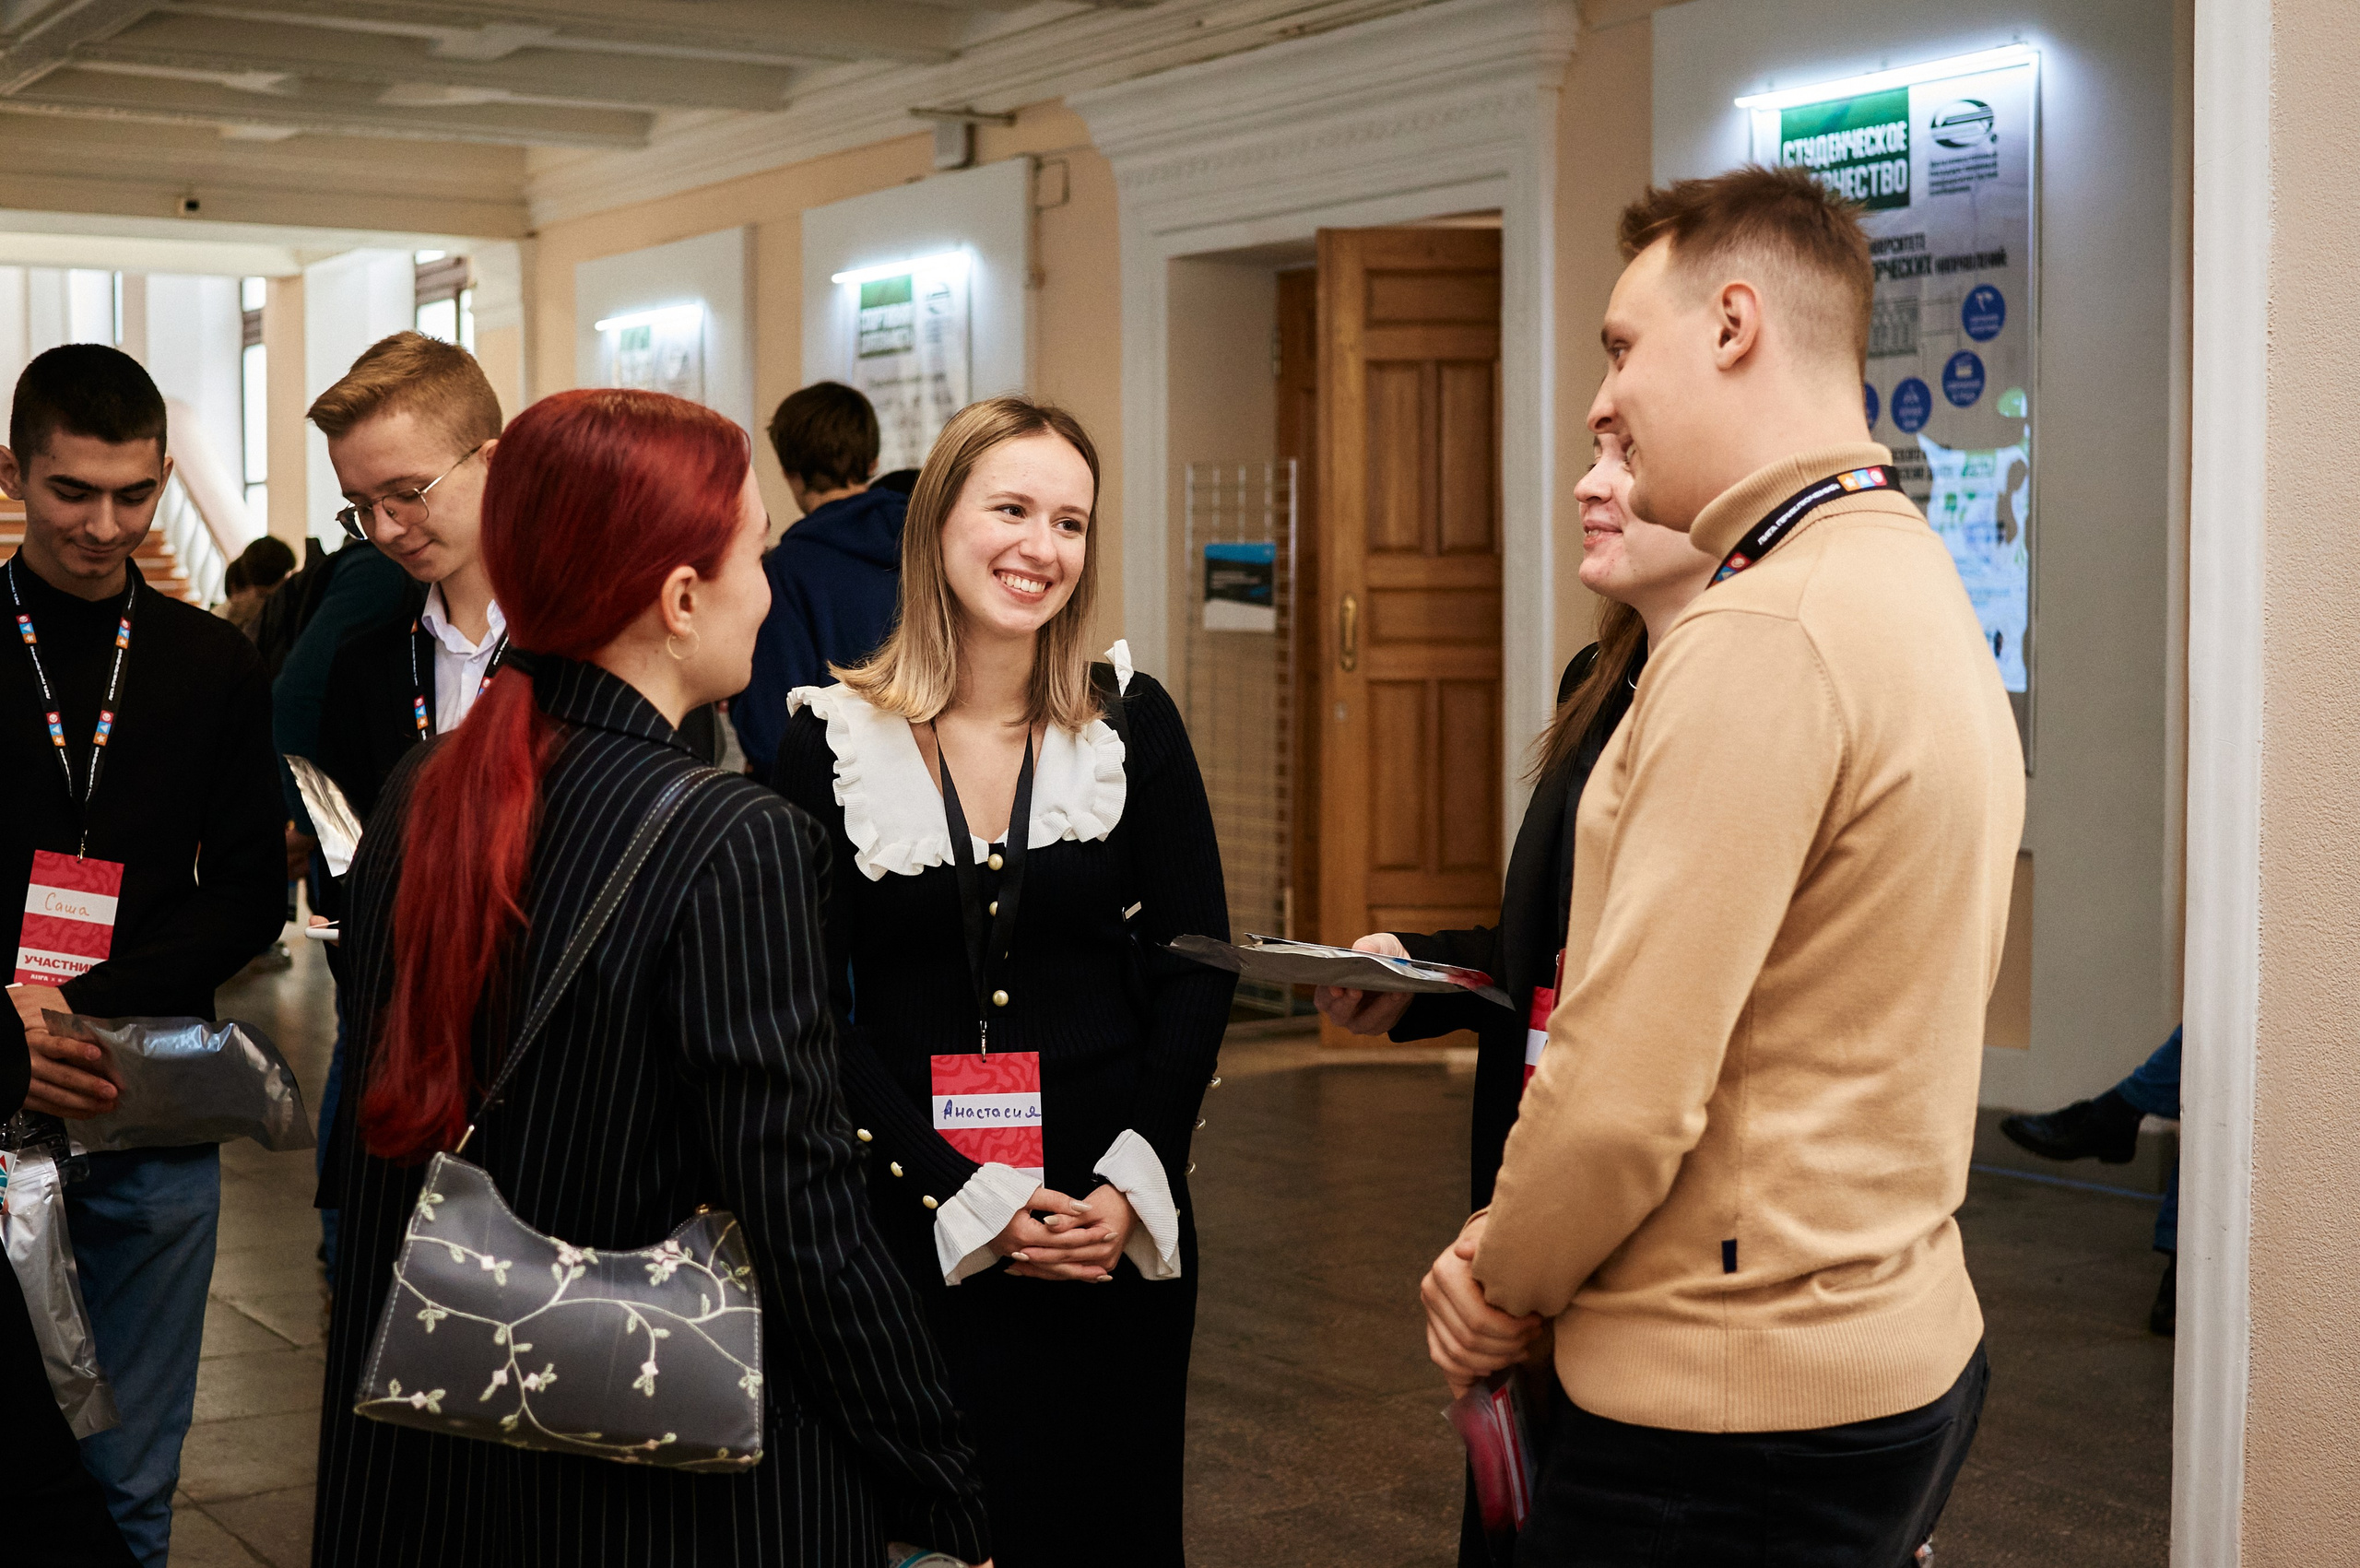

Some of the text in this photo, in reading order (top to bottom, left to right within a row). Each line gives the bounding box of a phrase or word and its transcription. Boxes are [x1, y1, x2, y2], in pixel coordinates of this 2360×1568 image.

[1782, 121, 1907, 169] СТУДЕНЧЕСКОЕ
[1809, 159, 1908, 201] РЧЕСТВО
[1873, 253, 1931, 281] РЧЕСКИХ
[1757, 483, 1841, 546] ЛИГА ПРИКЛЮЧЕНИЙ
[44, 892, 90, 916] Саша
[24, 955, 94, 973] УЧАСТНИ
[941, 1099, 1042, 1120] Анастасия
